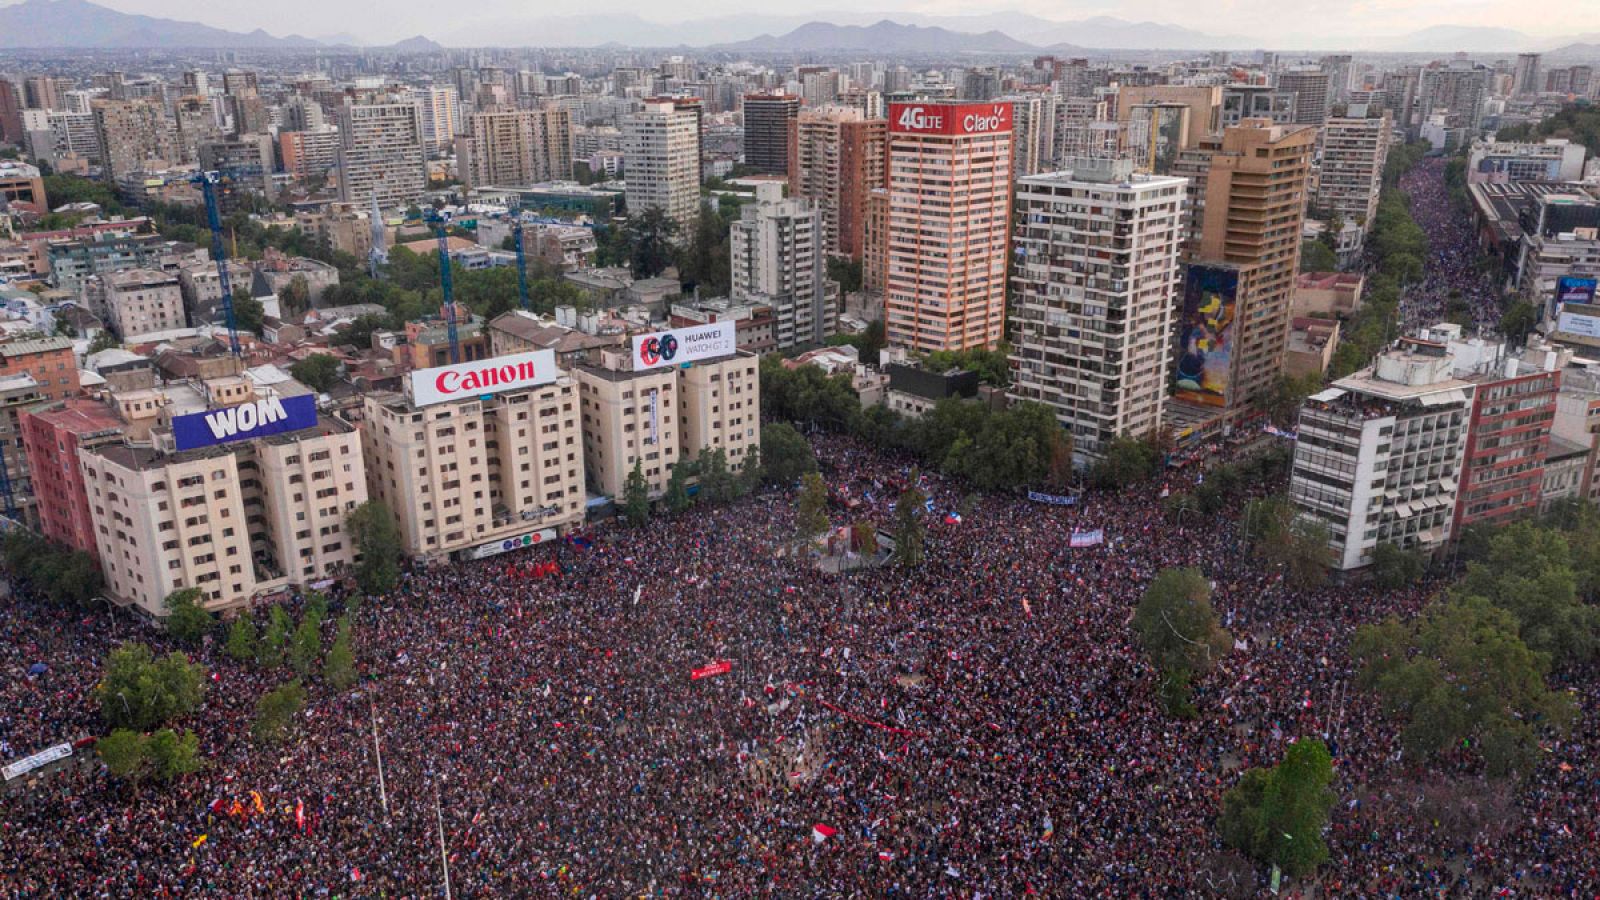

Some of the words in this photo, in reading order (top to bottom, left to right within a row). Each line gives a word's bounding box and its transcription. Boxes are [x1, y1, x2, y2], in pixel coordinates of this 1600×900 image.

[899, 107, 924, 130] 4G
[924, 116, 944, 128] LTE
[963, 114, 1000, 132] Claro
[685, 330, 721, 343] HUAWEI
[687, 342, 711, 354] WATCH
[712, 340, 723, 350] GT
[435, 360, 535, 394] Canon
[205, 395, 288, 439] WOM
